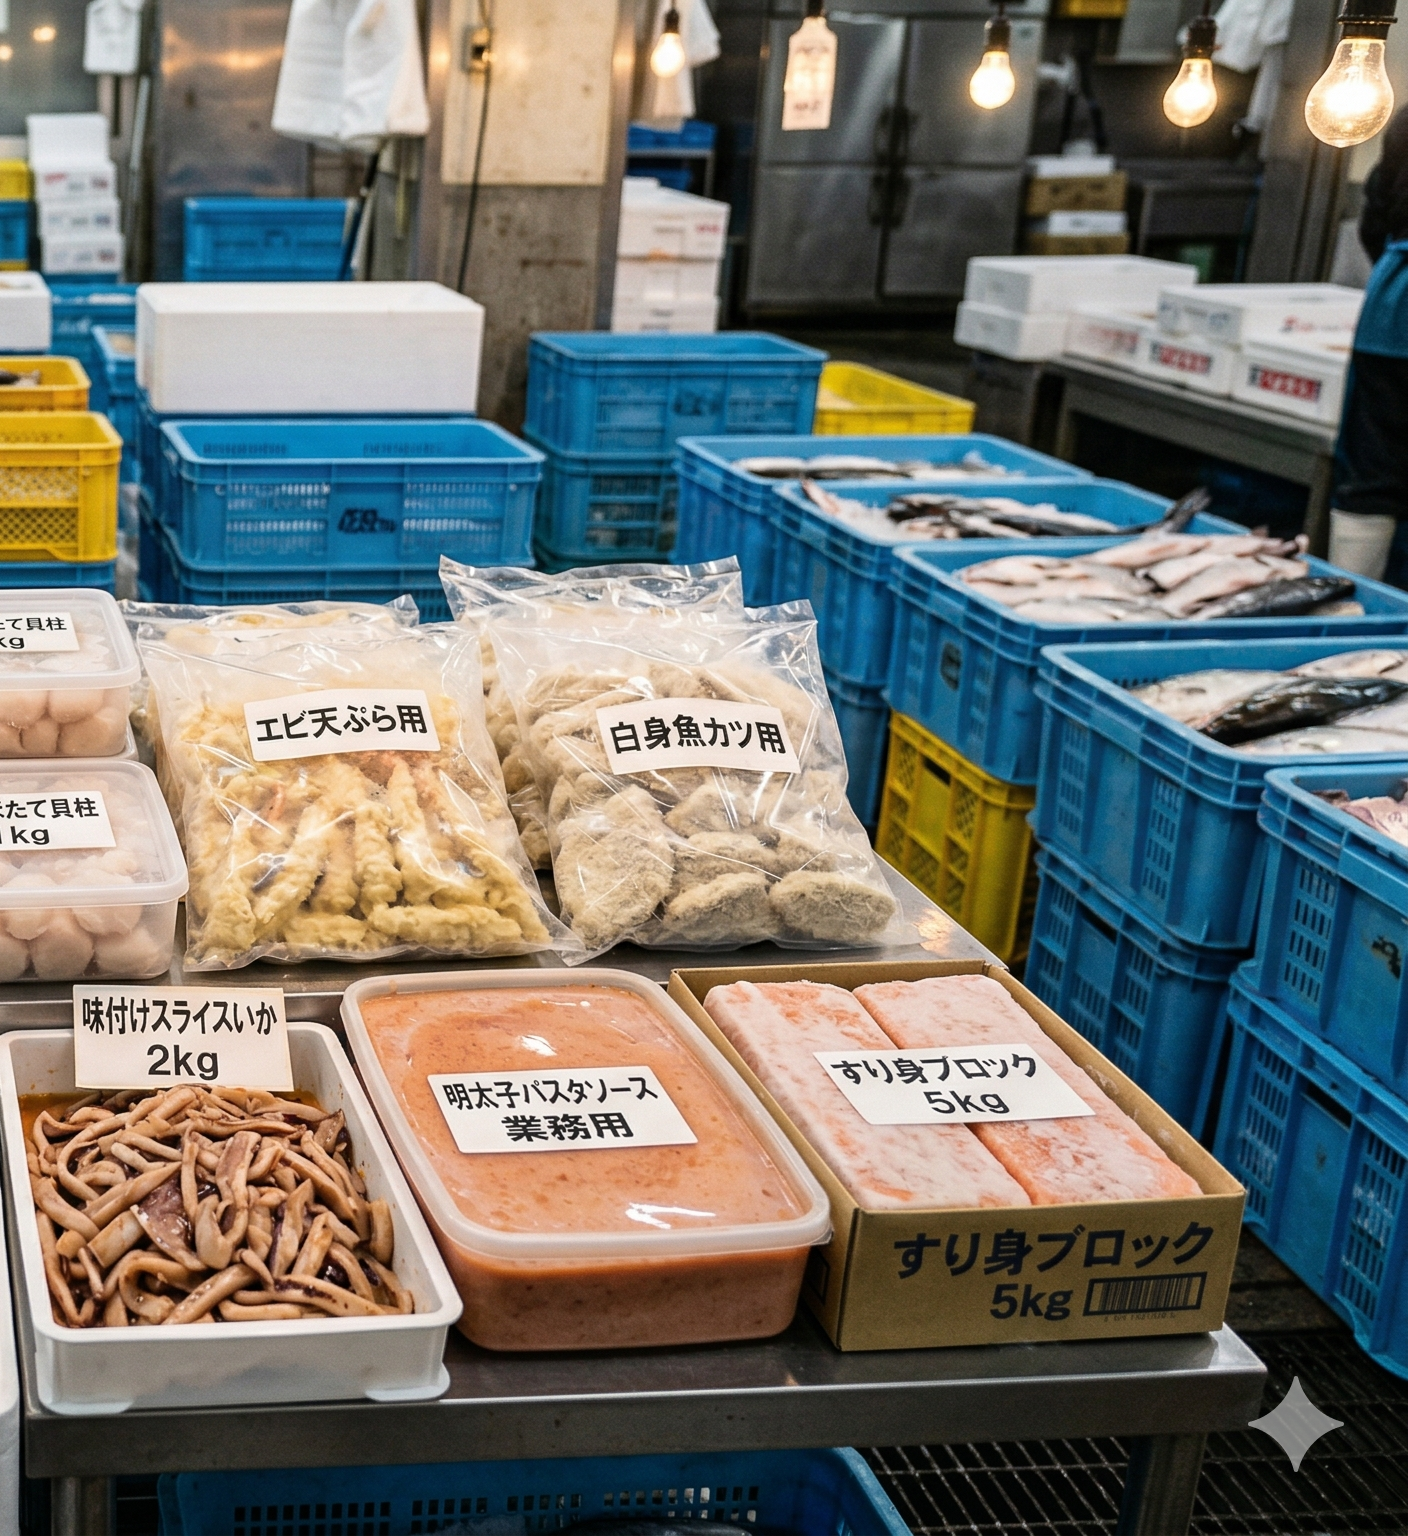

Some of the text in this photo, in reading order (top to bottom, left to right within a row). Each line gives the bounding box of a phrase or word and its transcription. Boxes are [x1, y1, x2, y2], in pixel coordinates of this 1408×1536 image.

[256, 704, 428, 742] エビ天ぷら用
[609, 714, 787, 754] 白身魚カツ用
[82, 996, 278, 1035] 味付けスライスいか
[146, 1044, 219, 1080] 2kg
[442, 1076, 659, 1110] 明太子パスタソース
[923, 1090, 1010, 1114] 5kg
[501, 1112, 635, 1142] 業務用
[893, 1221, 1215, 1279] すり身ブロック
[989, 1283, 1074, 1321] 5kg
